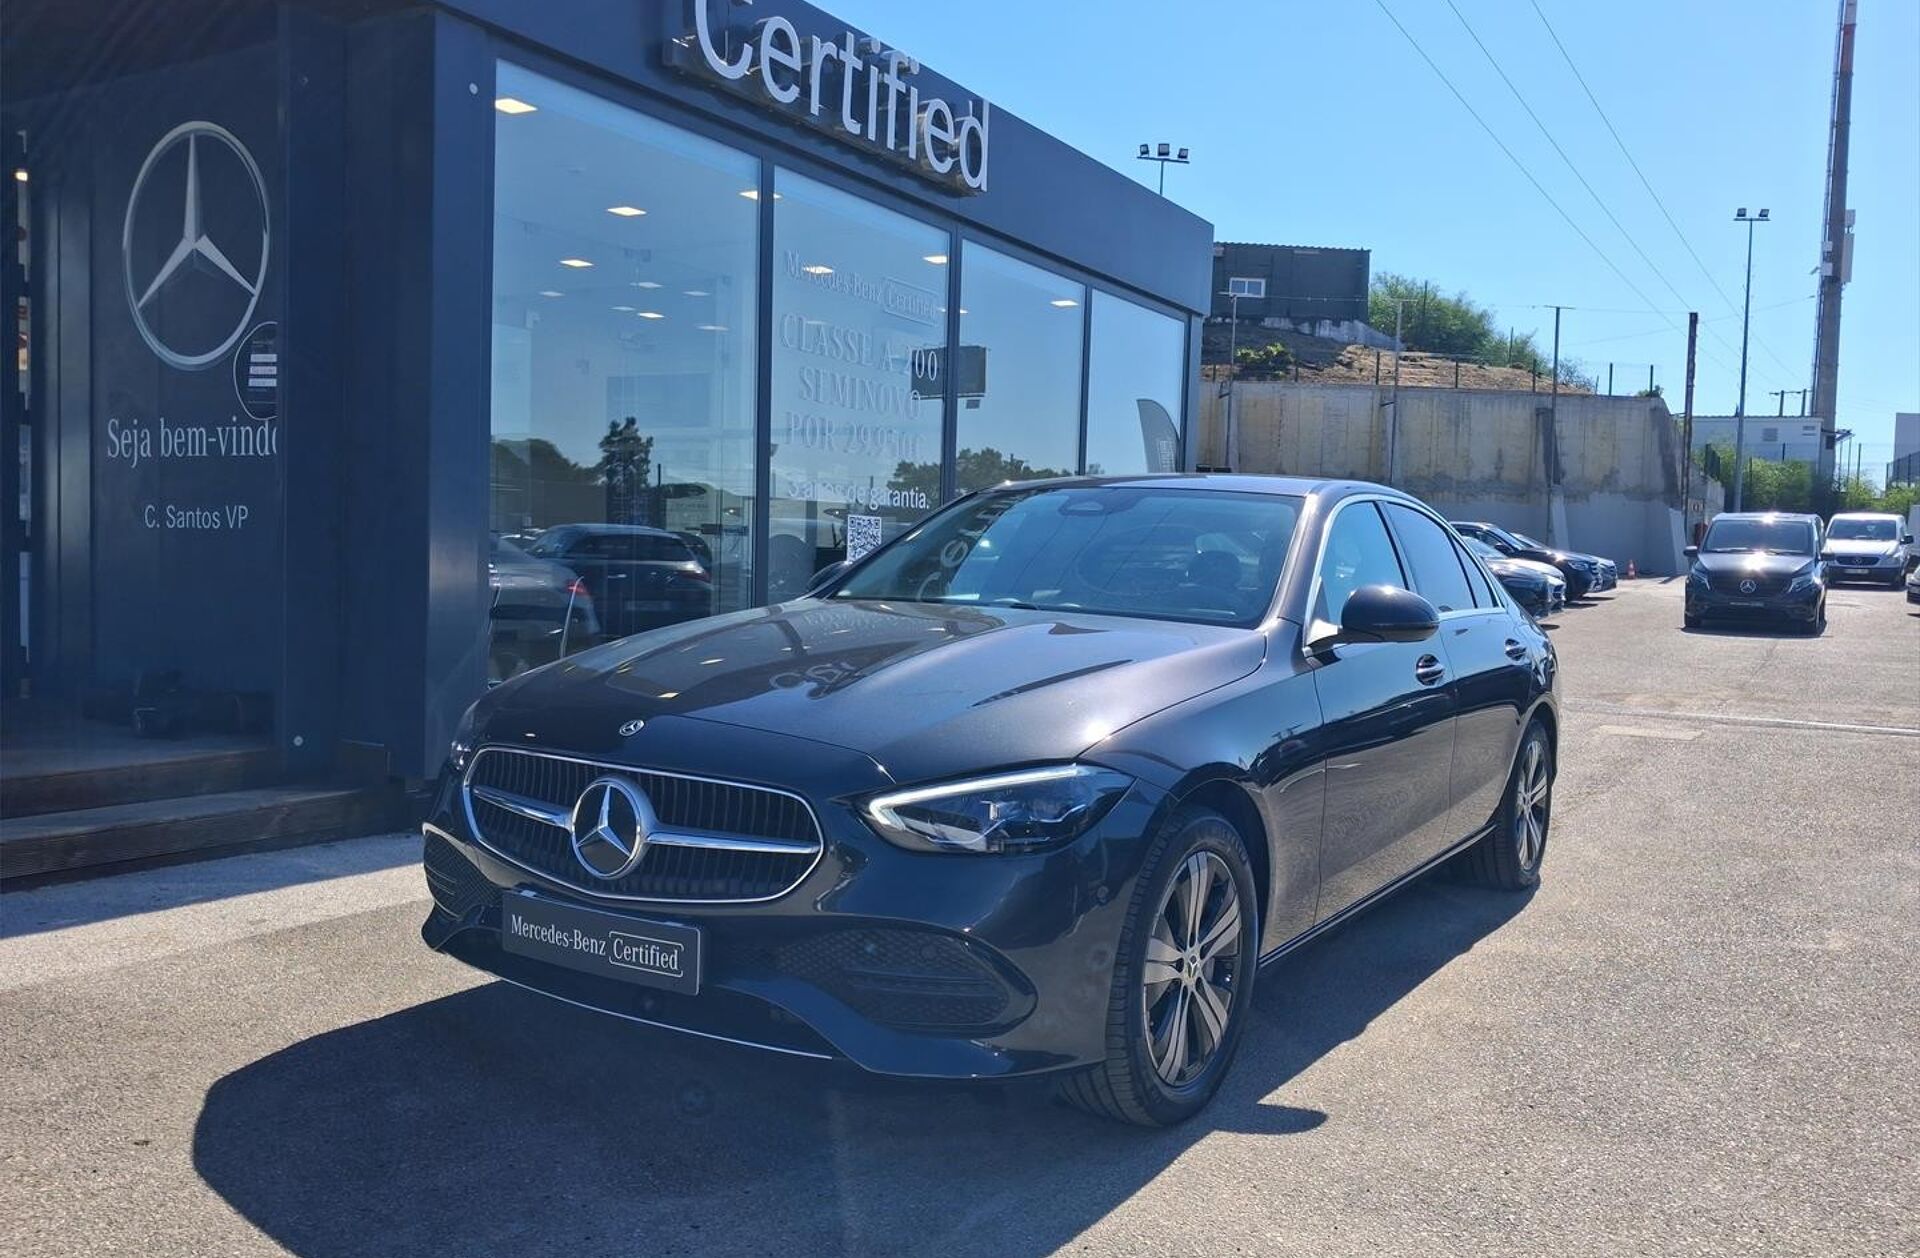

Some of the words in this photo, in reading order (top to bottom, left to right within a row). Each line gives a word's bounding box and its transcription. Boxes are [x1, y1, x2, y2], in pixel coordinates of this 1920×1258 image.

[694, 0, 989, 191] Certified
[783, 312, 874, 365] CLASSE
[801, 367, 921, 420] SEMINOVO
[107, 417, 152, 469] Seja
[787, 411, 836, 452] POR
[144, 504, 160, 530] C.
[166, 503, 221, 530] Santos
[226, 504, 249, 530] VP
[847, 483, 867, 507] de
[869, 485, 930, 511] garantia.
[511, 914, 606, 957] Mercedes-Benz
[612, 937, 678, 971] Certified
